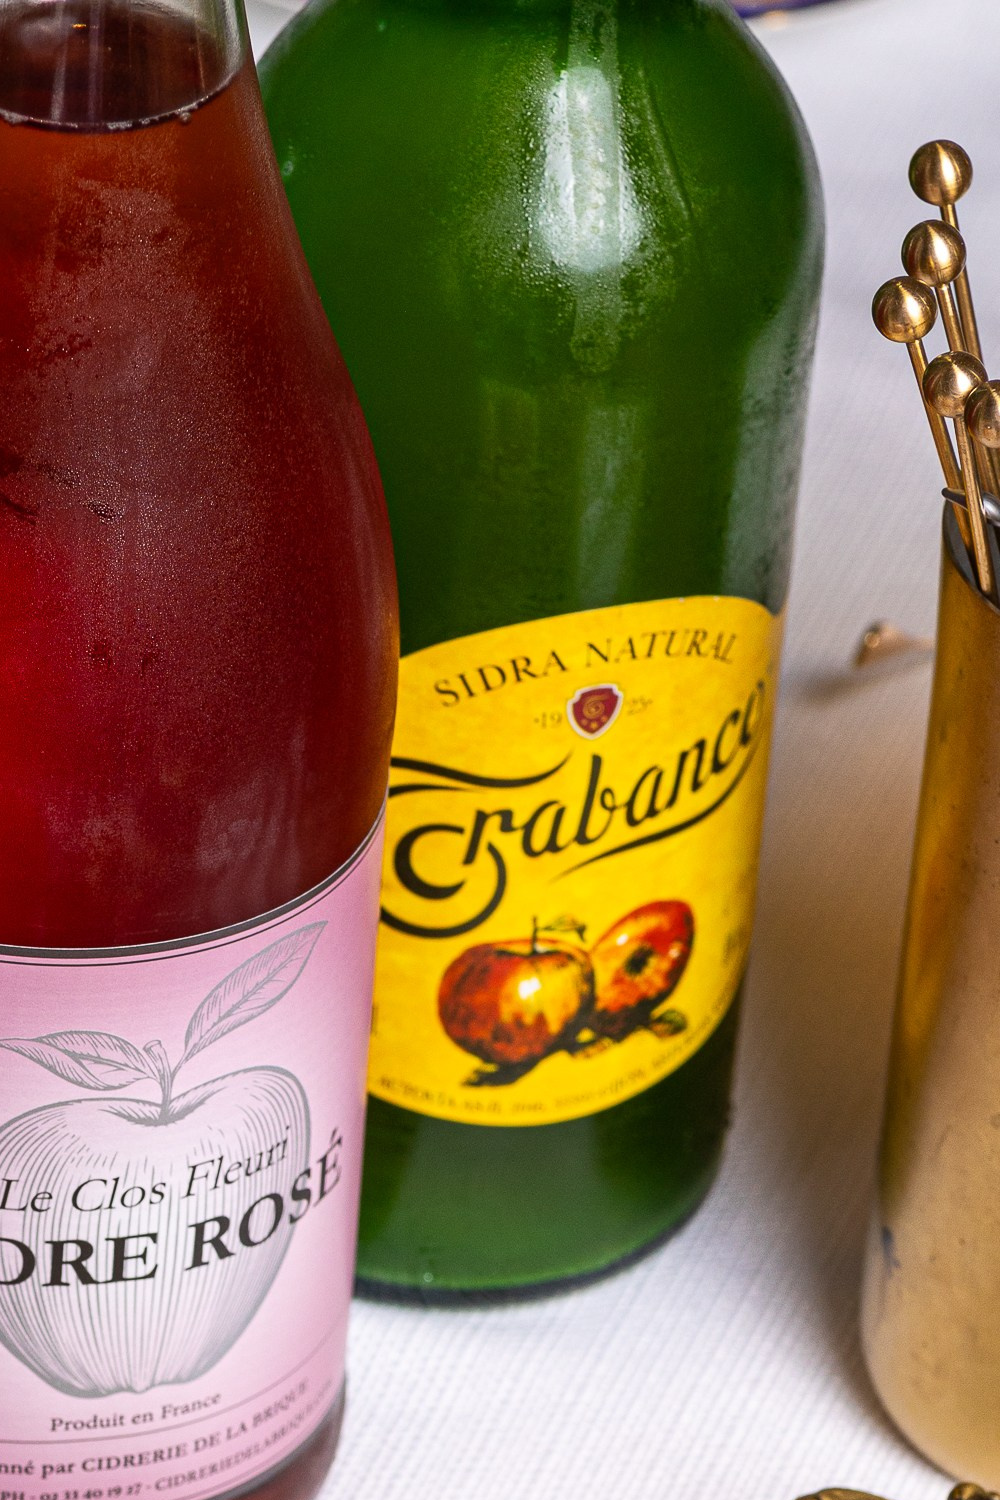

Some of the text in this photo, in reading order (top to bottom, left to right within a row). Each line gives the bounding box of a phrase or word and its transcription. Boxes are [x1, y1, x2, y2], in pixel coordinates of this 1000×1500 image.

[433, 628, 738, 708] SIDRA NATURAL
[71, 1168, 167, 1210] Clos
[182, 1125, 291, 1199] Fleuri
[185, 1127, 344, 1271] ROSÉ
[50, 1393, 222, 1432] Produit en France
[41, 1463, 76, 1480] par
[81, 1444, 190, 1473] CIDRERIE
[193, 1434, 222, 1454] DE
[225, 1422, 248, 1442] LA
[82, 1488, 102, 1500] 40
[107, 1485, 122, 1499] 19
